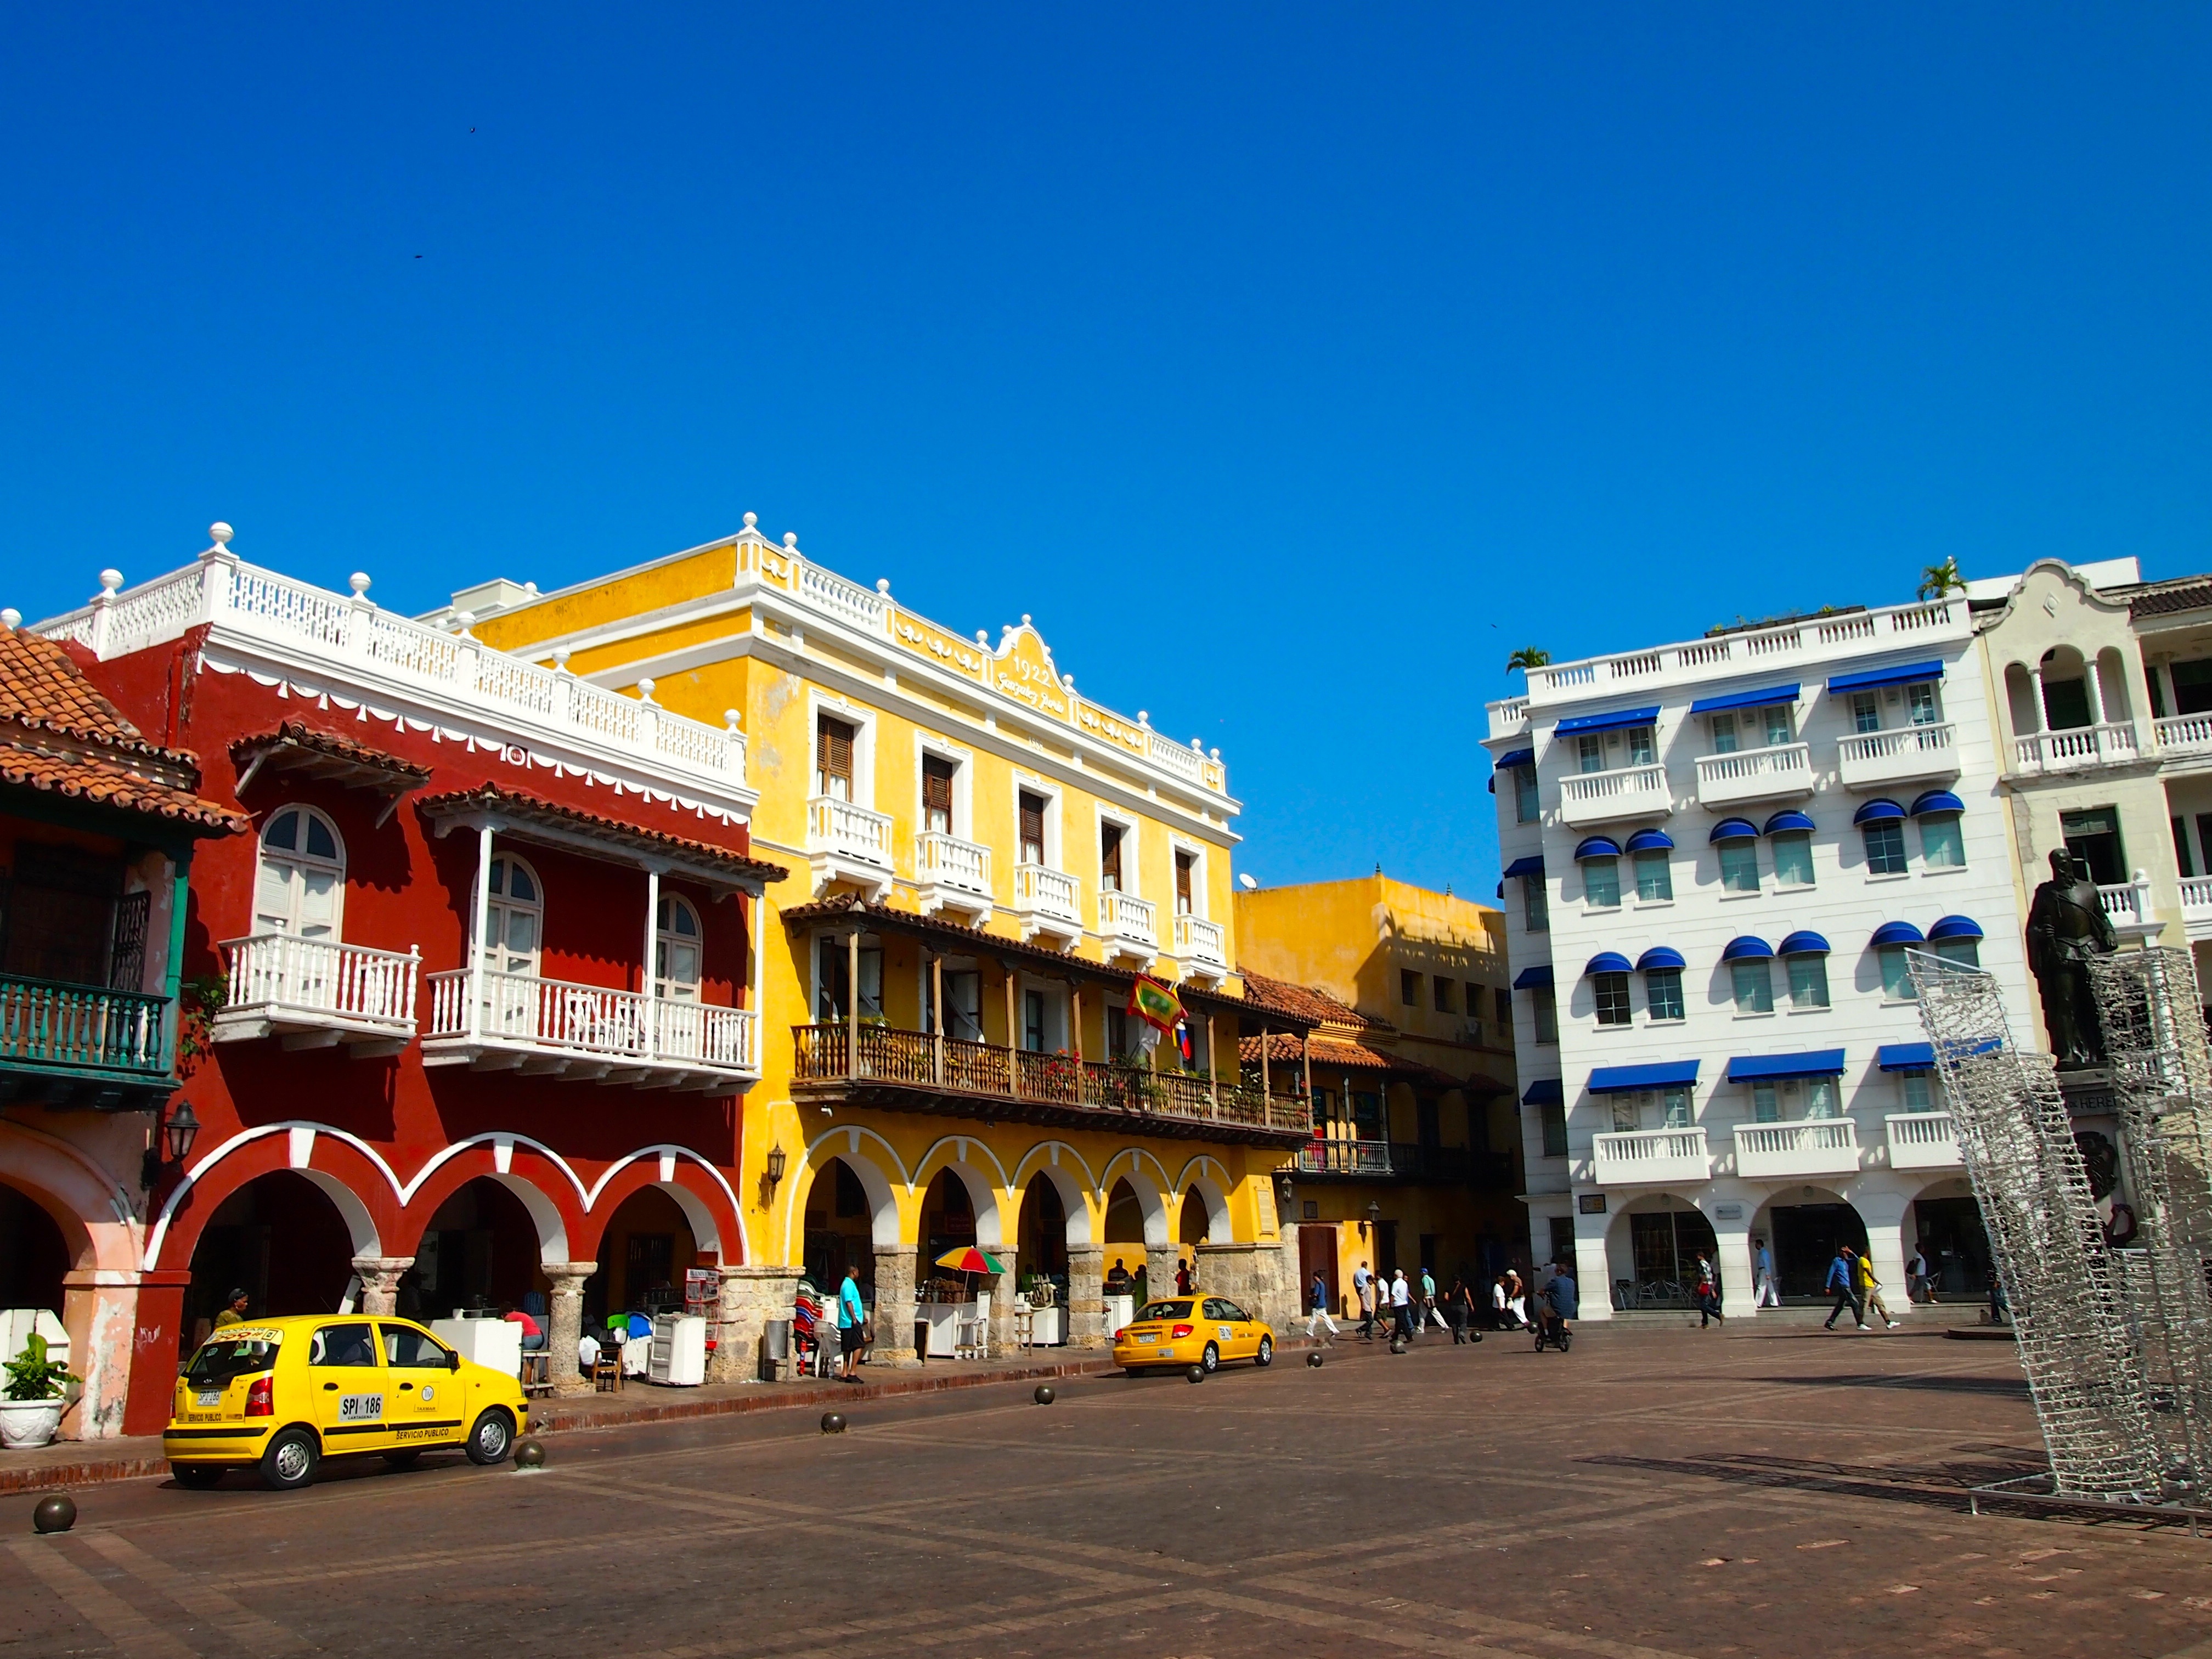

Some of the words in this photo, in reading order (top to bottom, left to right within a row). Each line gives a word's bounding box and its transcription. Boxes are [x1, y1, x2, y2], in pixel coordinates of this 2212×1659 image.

[1014, 656, 1052, 688] 1922
[2080, 1095, 2117, 1109] HERE
[343, 1398, 358, 1415] SPI
[365, 1397, 381, 1414] 186
[205, 1413, 221, 1421] PUBLICO
[396, 1430, 423, 1440] SERVICIO
[424, 1428, 449, 1437] PUBLICO
